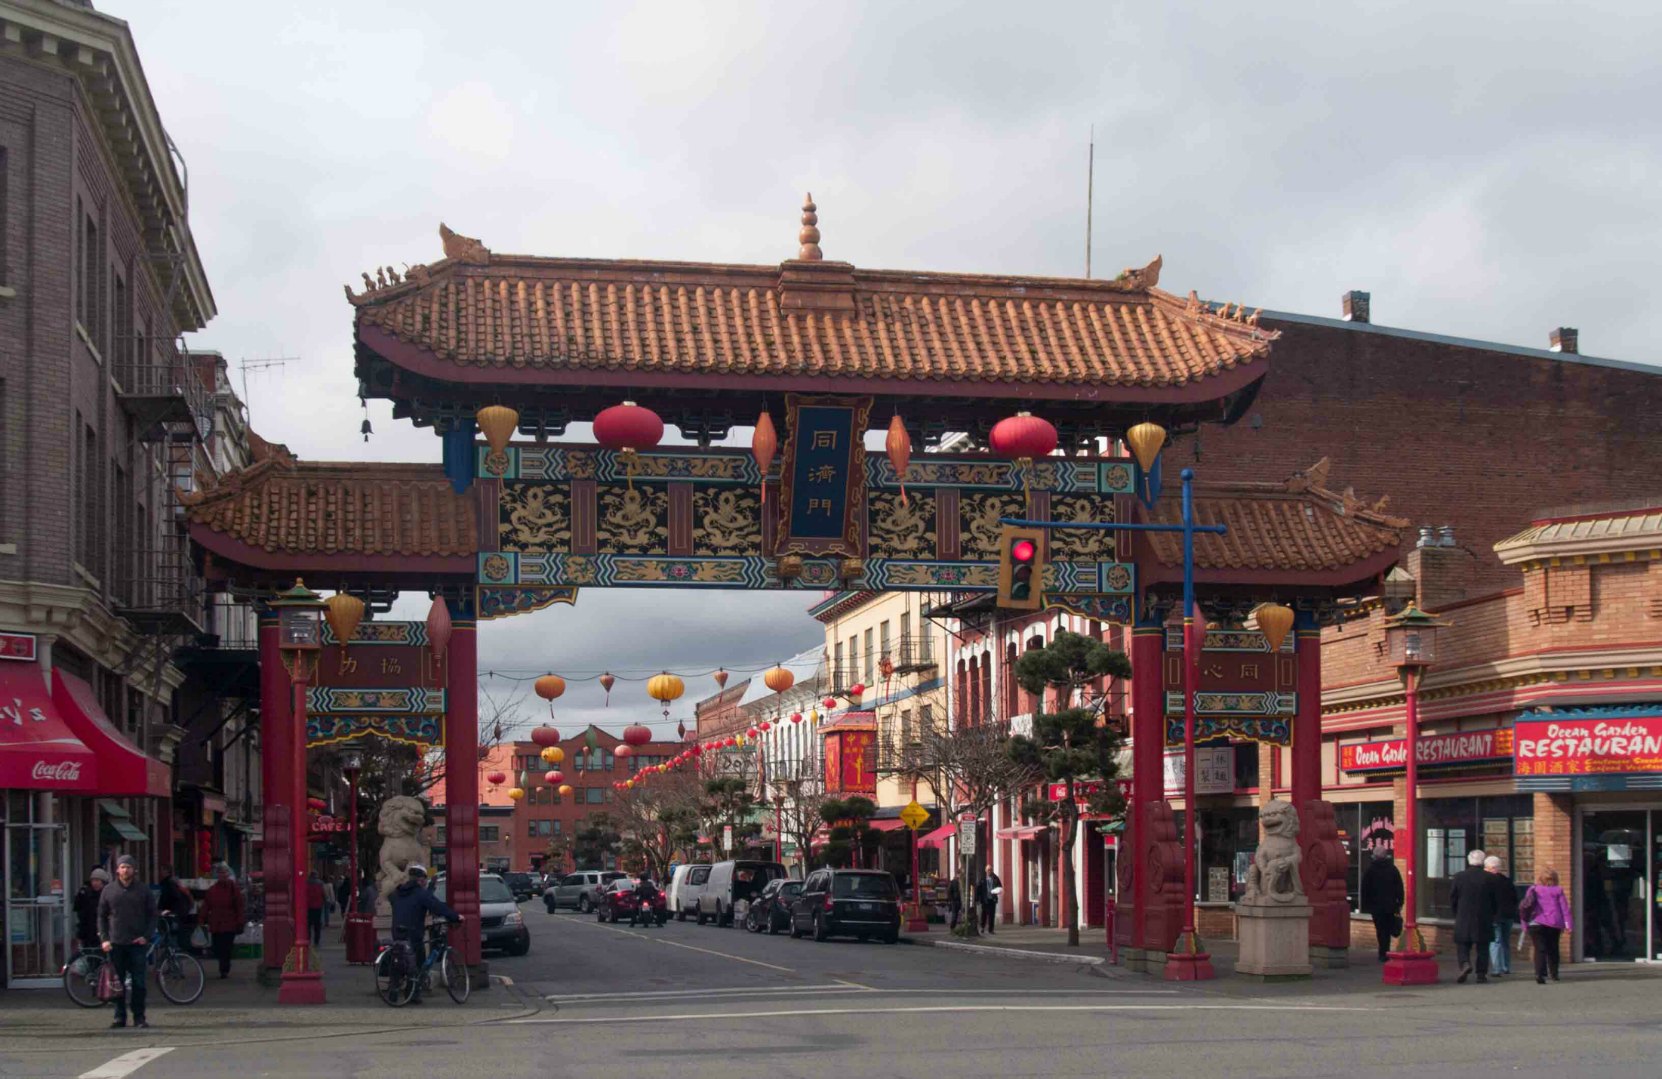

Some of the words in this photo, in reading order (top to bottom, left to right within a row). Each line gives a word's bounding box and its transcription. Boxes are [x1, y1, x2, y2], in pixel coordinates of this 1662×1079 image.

[806, 429, 838, 517] 同濟門
[1547, 723, 1589, 738] Ocean
[1594, 722, 1648, 737] Garden
[1356, 745, 1379, 765] Ocean
[1382, 741, 1408, 763] Garde
[1416, 734, 1492, 761] RESTAURANT
